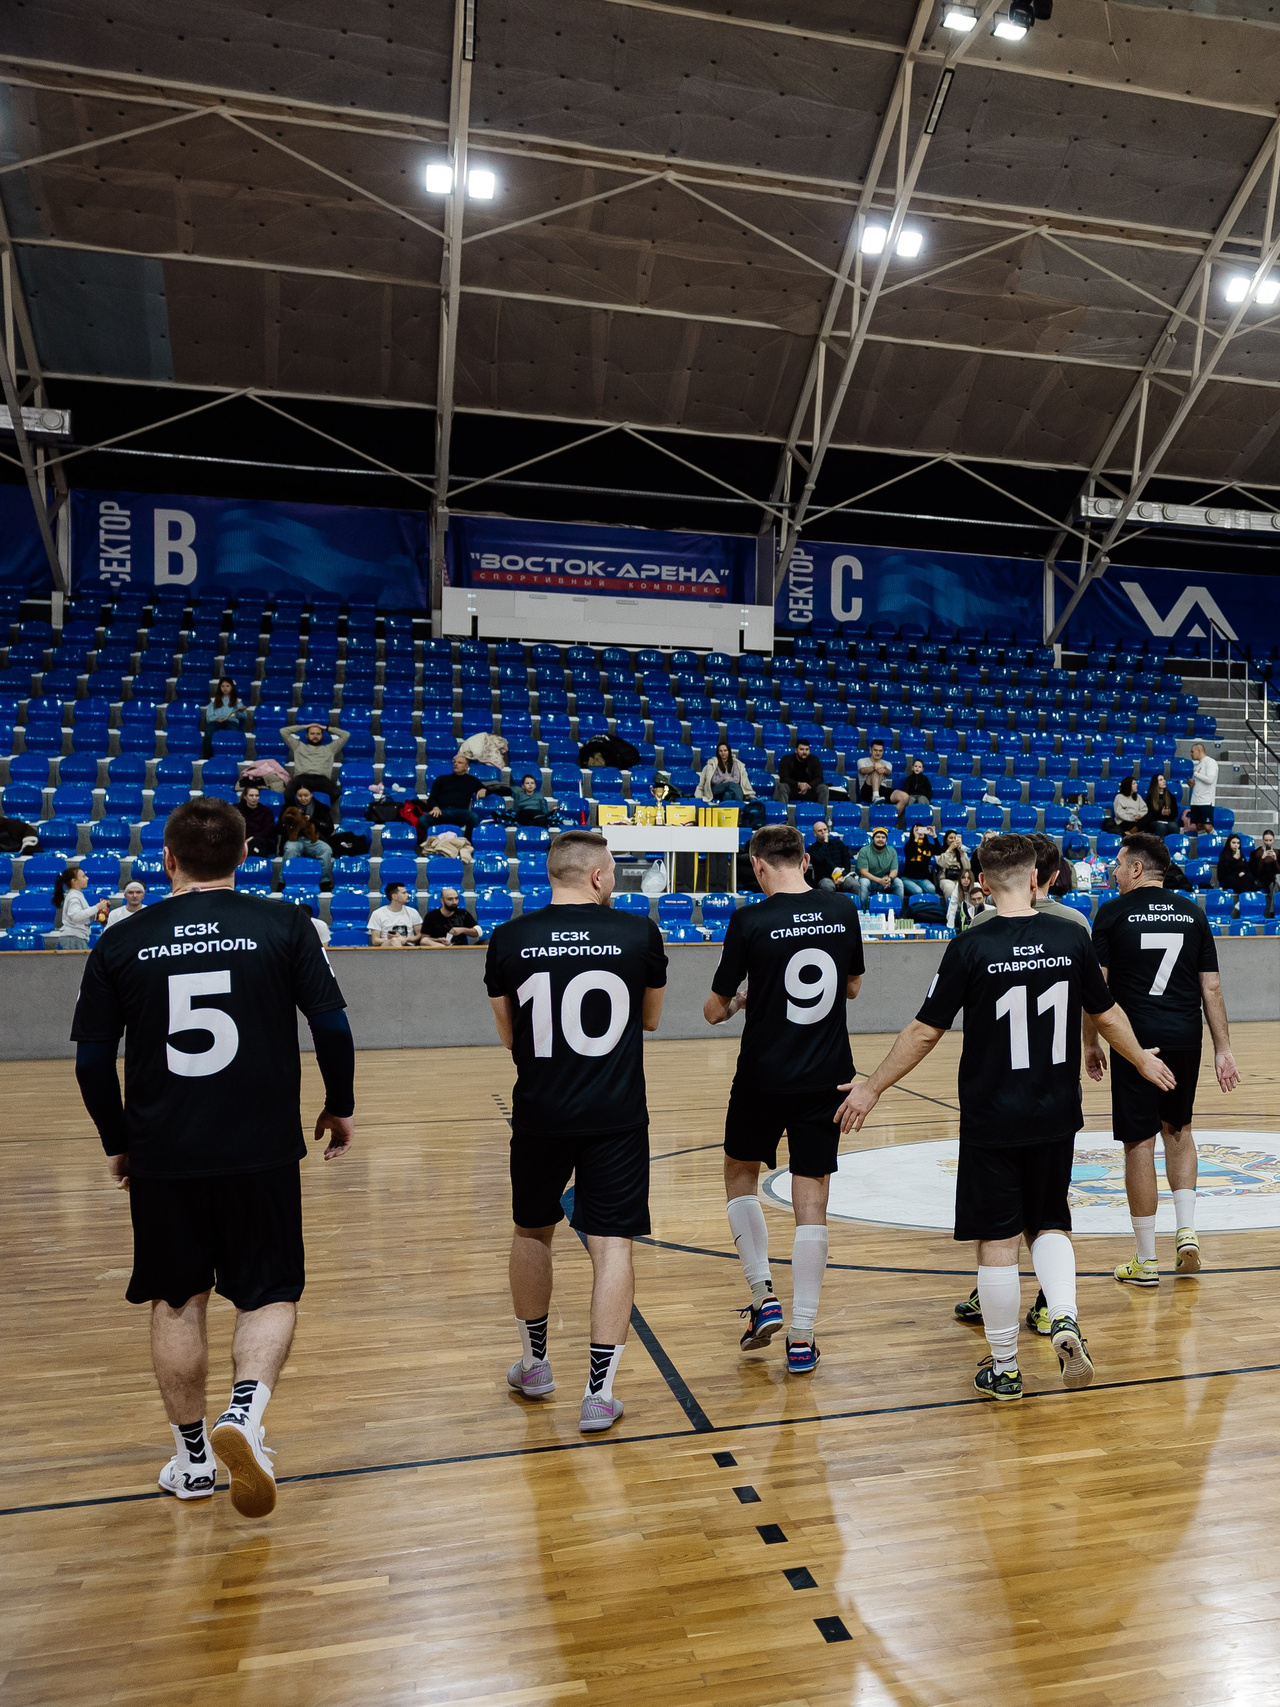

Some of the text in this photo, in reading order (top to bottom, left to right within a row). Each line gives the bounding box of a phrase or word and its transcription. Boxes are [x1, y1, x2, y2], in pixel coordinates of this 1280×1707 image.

[153, 508, 198, 586] B
[479, 572, 721, 595] СПОРТИВНЫЙ КОМПЛЕКС
[788, 547, 814, 623] СЕКТОР
[830, 554, 863, 622] C
[793, 912, 823, 923] ЕСЗК
[1127, 914, 1194, 923] СТАВРОПОЛЬ
[1148, 904, 1174, 912] ЕСЗК
[173, 921, 220, 938] ЕСЗК
[551, 931, 590, 942] ЕСЗК
[770, 924, 846, 940] СТАВРОПОЛЬ
[137, 938, 258, 961] СТАВРОПОЛЬ
[520, 944, 622, 959] СТАВРОПОЛЬ
[1012, 943, 1045, 957] ЕСЗК
[987, 955, 1072, 974] СТАВРОПОЛЬ
[1140, 932, 1184, 996] 7
[784, 948, 837, 1025] 9
[166, 970, 239, 1077] 5
[516, 970, 630, 1058] 10
[996, 980, 1068, 1070] 11
